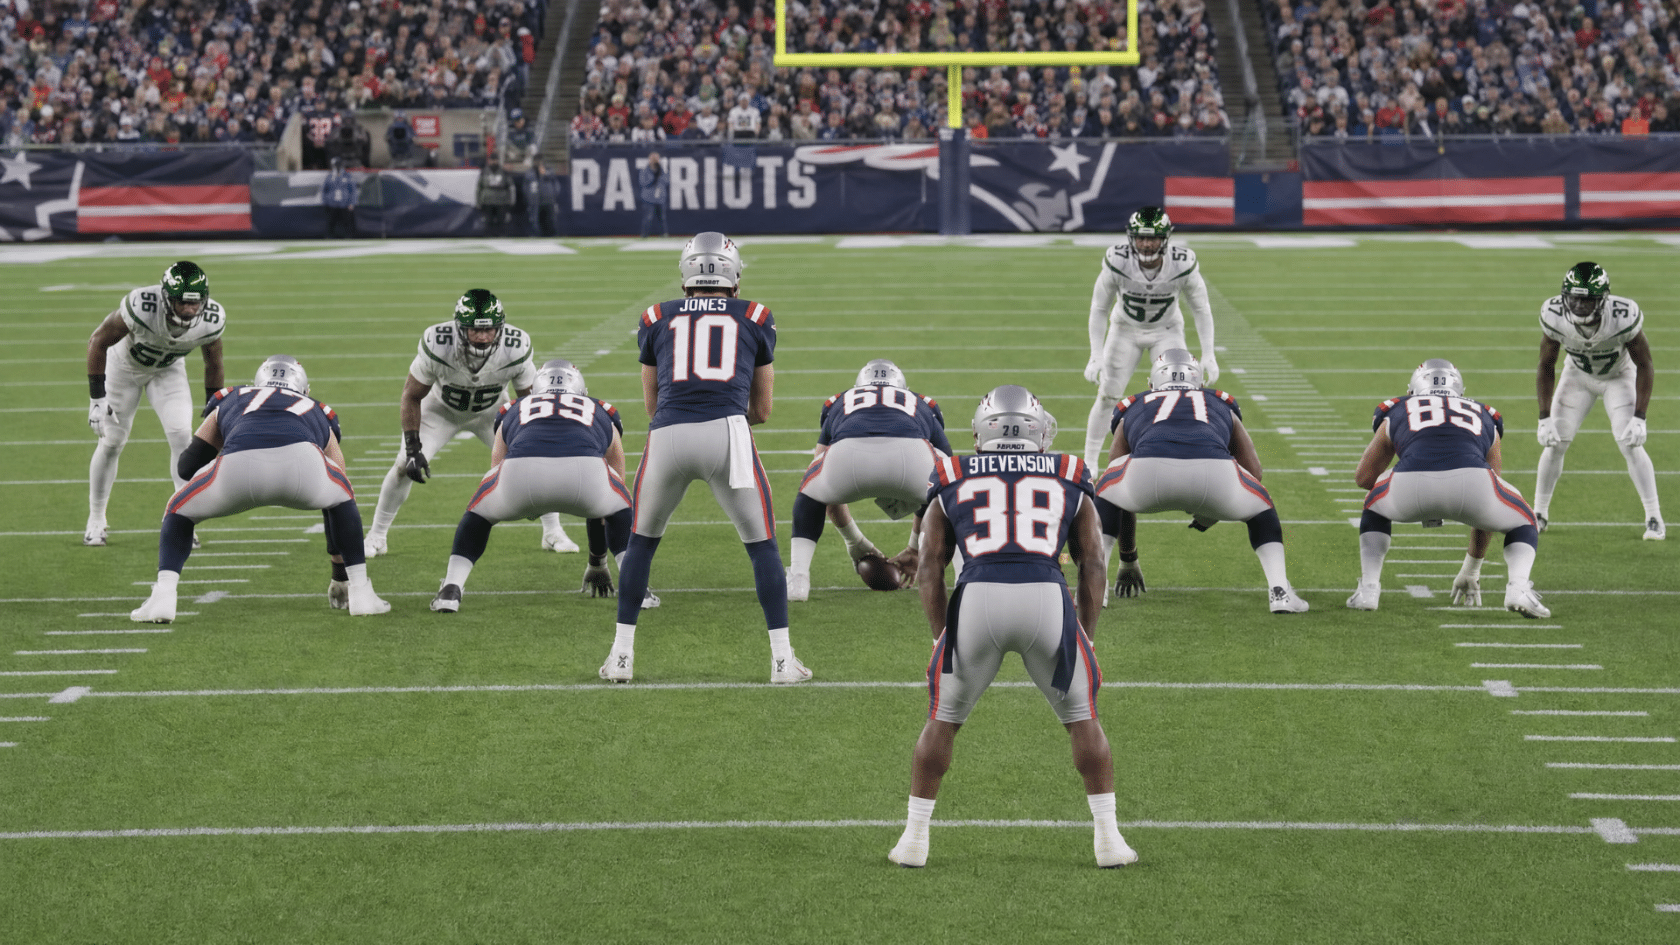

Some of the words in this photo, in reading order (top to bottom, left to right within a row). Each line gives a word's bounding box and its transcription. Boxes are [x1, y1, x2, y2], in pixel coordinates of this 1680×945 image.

[571, 156, 817, 211] PARIOTS
[699, 263, 715, 274] 10
[140, 291, 157, 314] 56
[203, 303, 220, 324] 56
[679, 298, 727, 312] JONES
[1612, 300, 1630, 319] 37
[435, 326, 453, 346] 95
[668, 313, 739, 382] 10
[238, 386, 316, 416] 77
[519, 393, 596, 427] 69
[843, 385, 918, 418] 60
[1144, 389, 1210, 424] 71
[1405, 395, 1482, 436] 85
[957, 474, 1067, 558] 38
